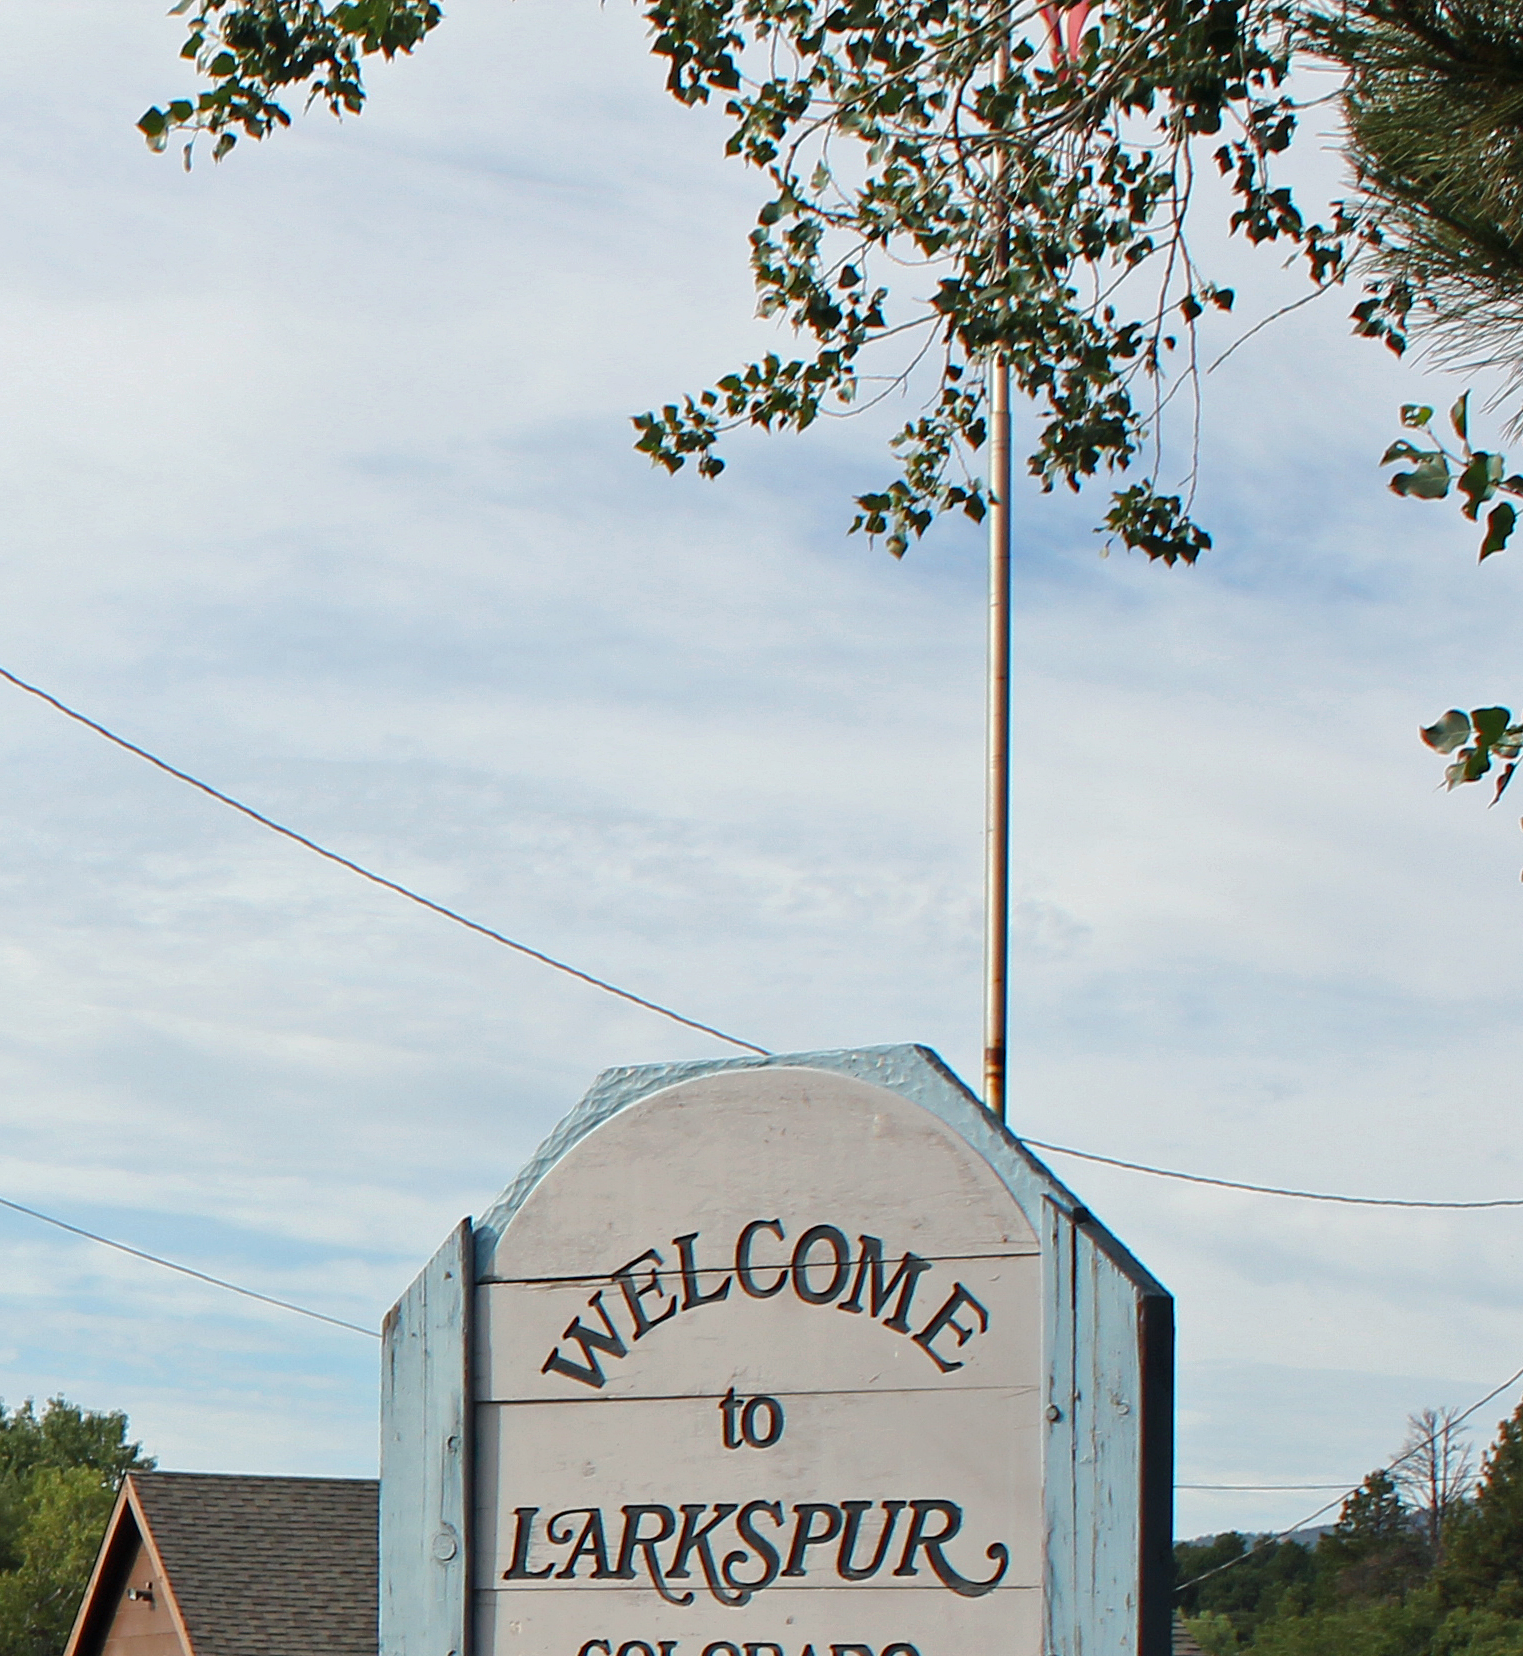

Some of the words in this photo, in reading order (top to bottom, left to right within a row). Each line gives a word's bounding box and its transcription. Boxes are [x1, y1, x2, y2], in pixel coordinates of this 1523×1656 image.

[541, 1218, 990, 1389] WELCOME
[718, 1387, 784, 1449] to
[502, 1499, 1009, 1607] LARKSPUR
